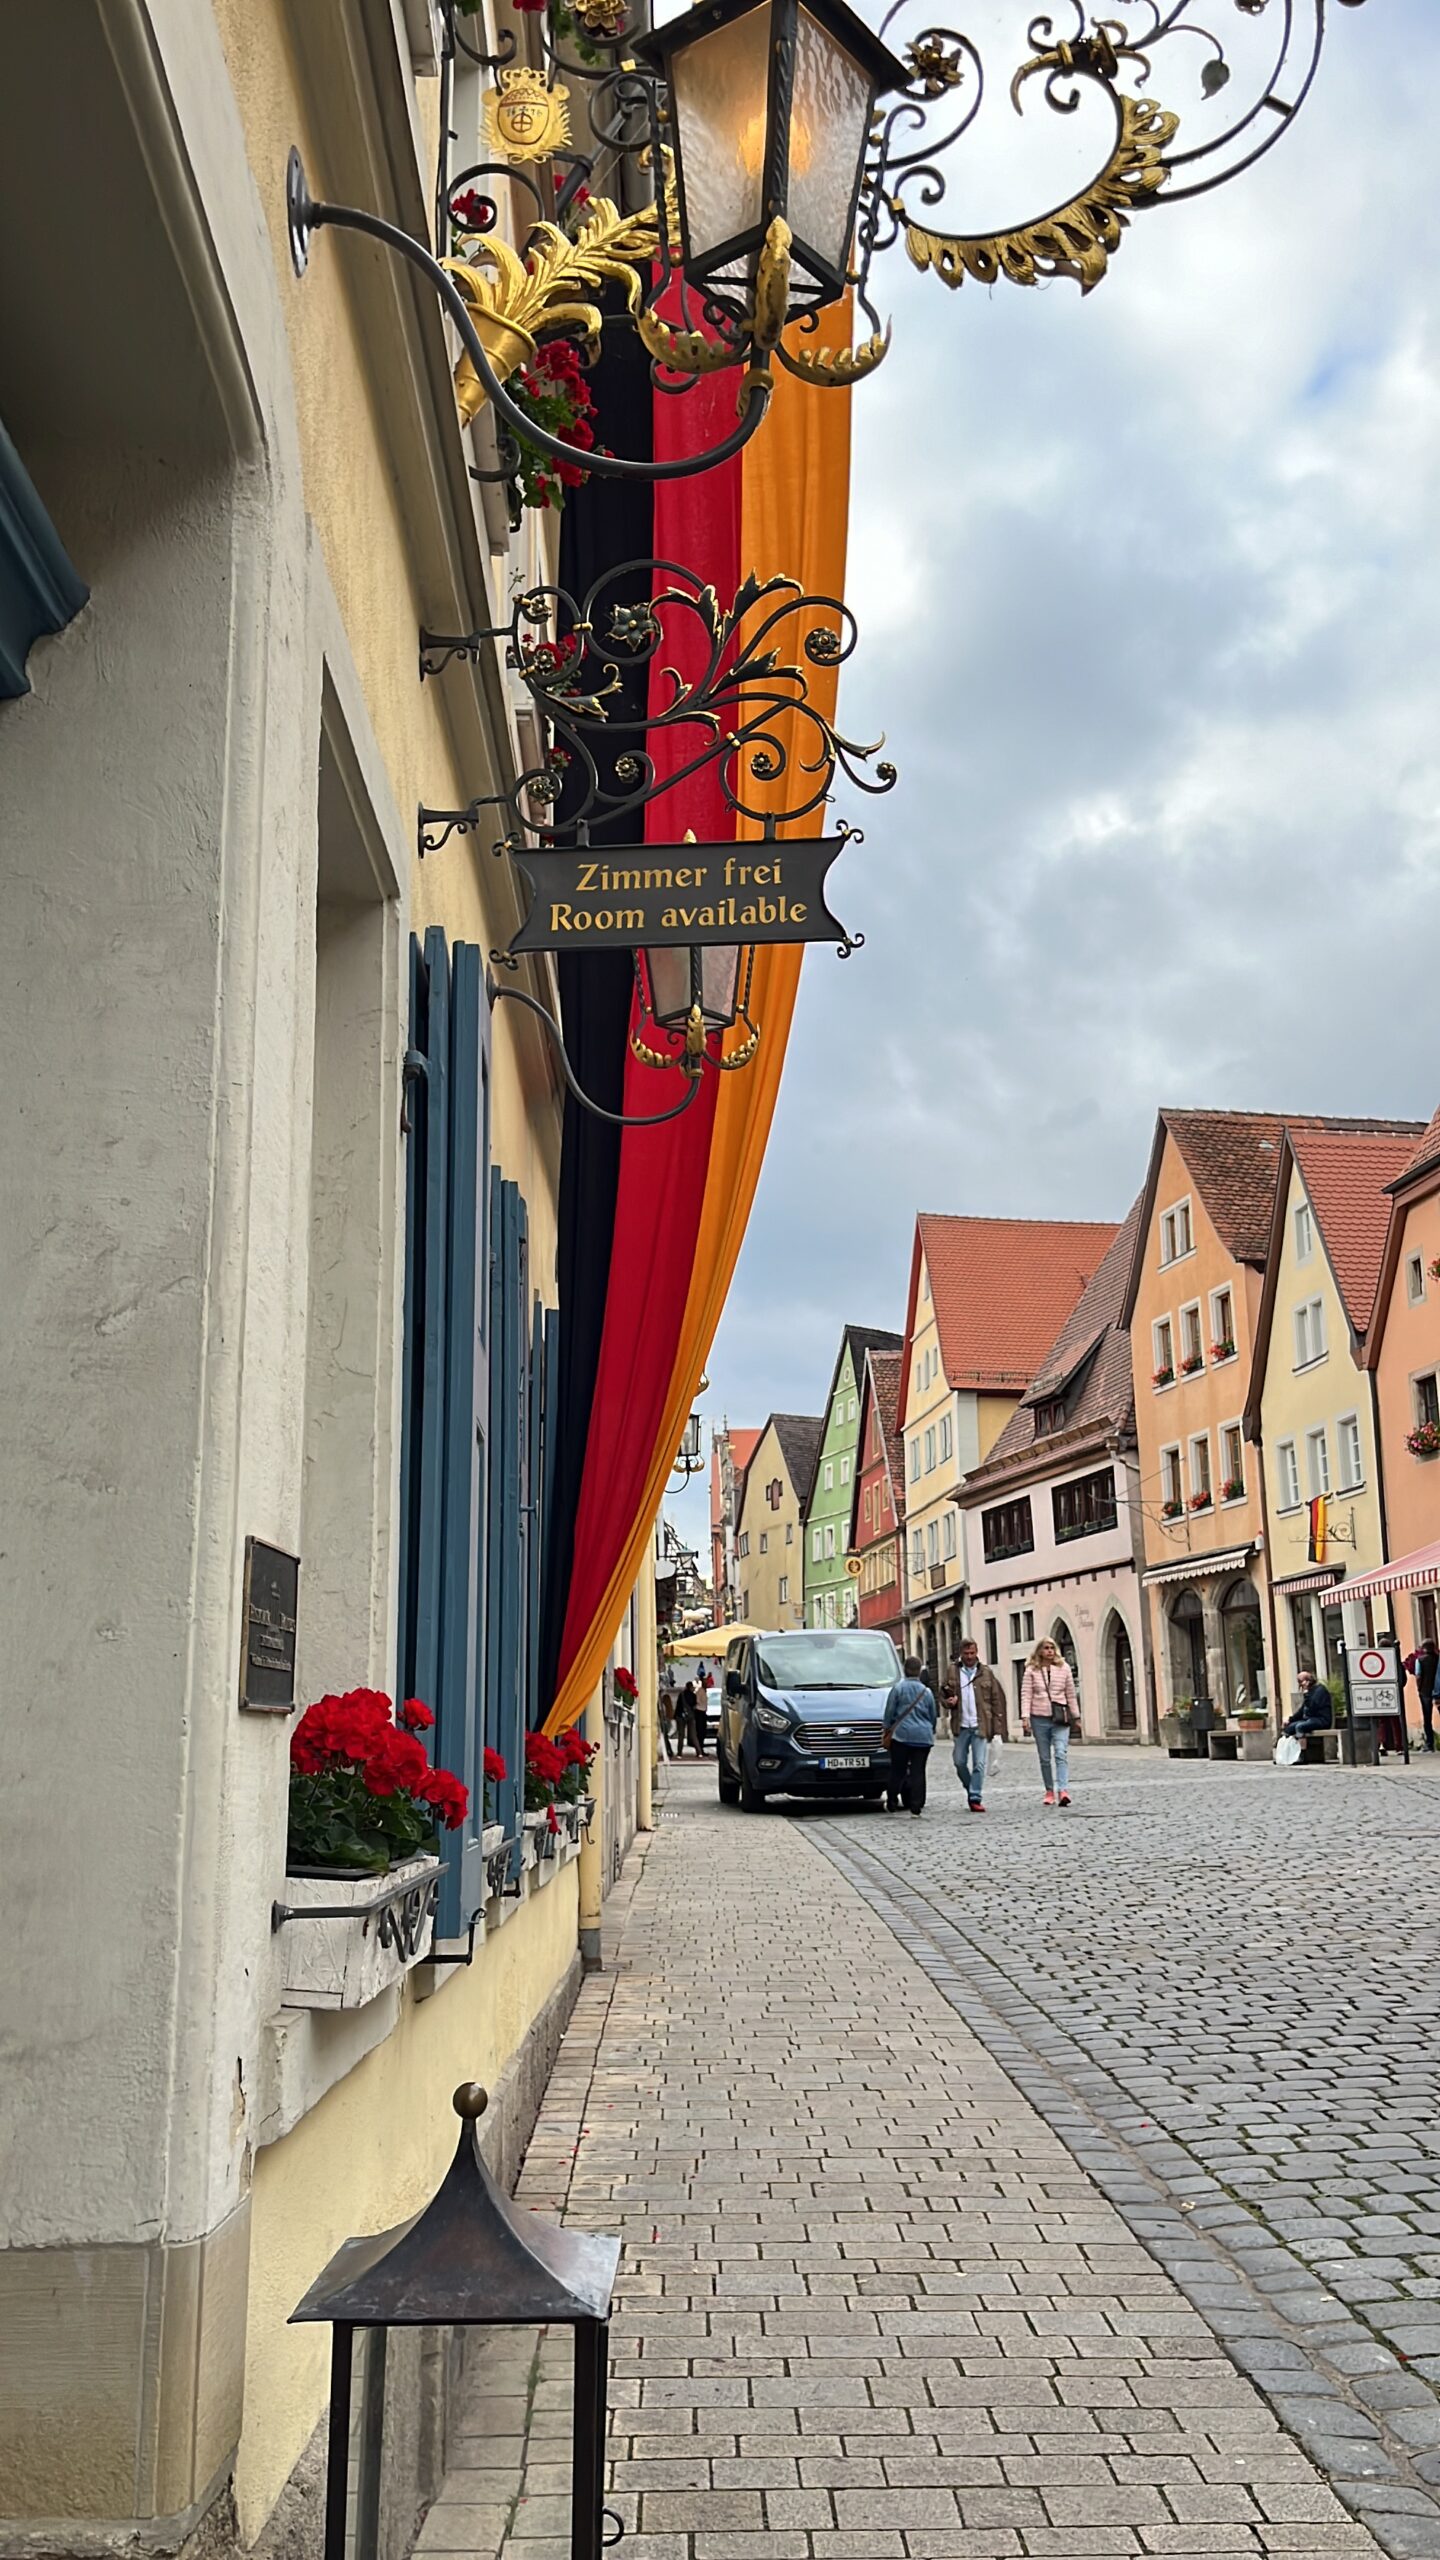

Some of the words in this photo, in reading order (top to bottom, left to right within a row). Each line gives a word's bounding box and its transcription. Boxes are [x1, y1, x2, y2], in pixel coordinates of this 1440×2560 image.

[576, 863, 708, 891] Zimmer
[724, 858, 782, 886] frei
[550, 904, 645, 931] Room
[661, 896, 807, 928] available
[844, 1758, 855, 1767] TR
[855, 1757, 866, 1766] 51
